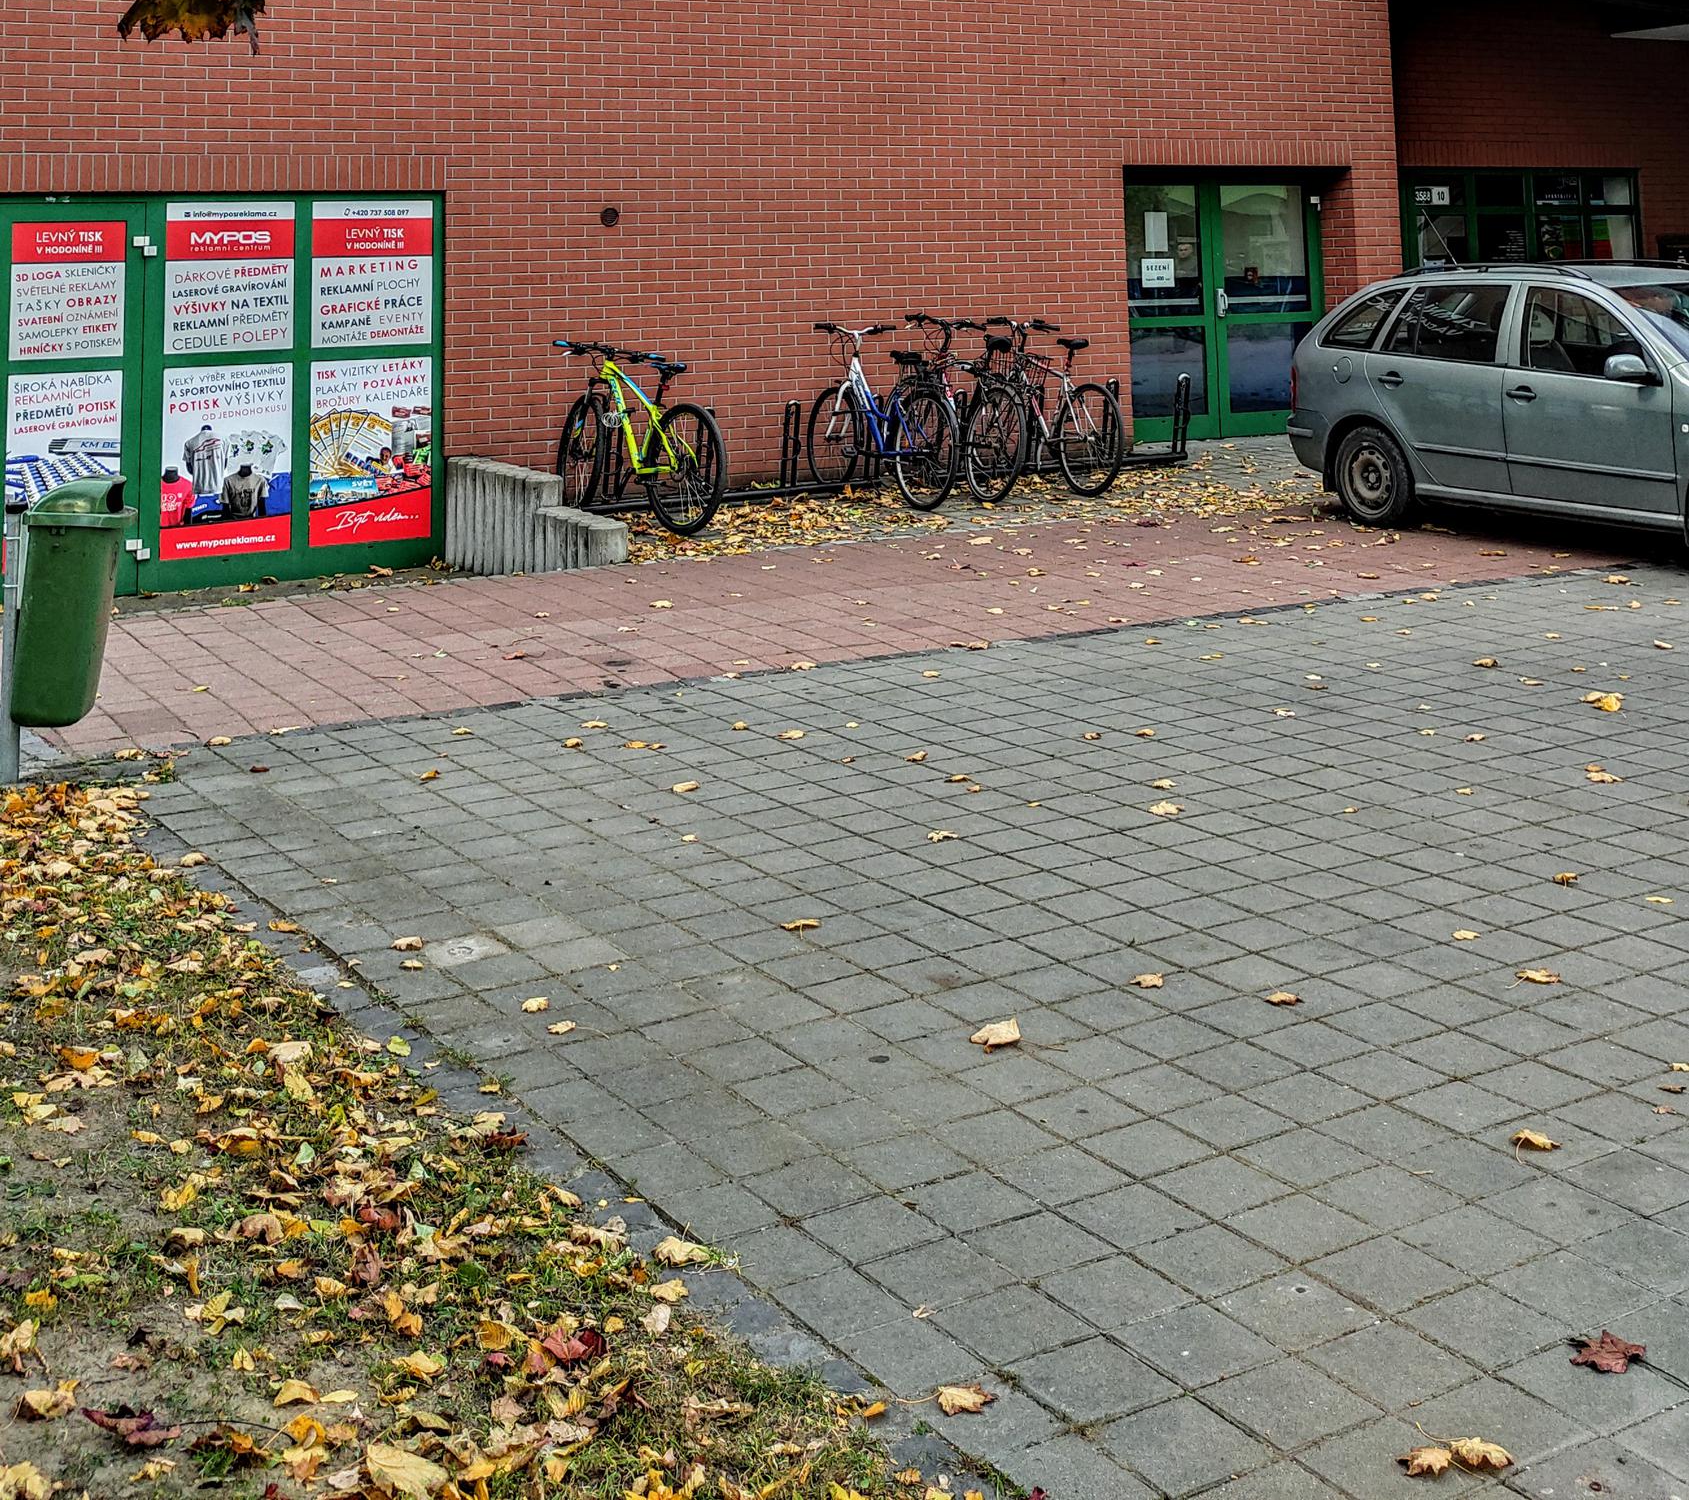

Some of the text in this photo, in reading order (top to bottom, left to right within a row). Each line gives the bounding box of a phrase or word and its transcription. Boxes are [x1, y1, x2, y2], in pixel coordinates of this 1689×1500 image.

[1437, 191, 1445, 201] 10
[193, 210, 277, 219] info@myposreklama.cz
[36, 229, 103, 242] LEVNÝ TISK
[190, 231, 271, 245] MYPOS
[346, 227, 404, 239] LEVNÝ TISK
[36, 246, 42, 254] V
[45, 244, 93, 254] HODONÍNĚ
[354, 240, 396, 249] HODONÍNĚ
[16, 265, 117, 282] 3D LOGA SKLENIČKY
[175, 264, 288, 284] DÁRKOVÉ PŘEDMĚTY
[320, 259, 418, 278] MARKETING
[16, 280, 117, 298] SVĚTELNÉ REKLAMY
[172, 278, 287, 298] LASEROVÉ GRAVÍROVÁNÍ
[320, 278, 420, 296] REKLAMNÍ PLOCHY
[17, 294, 117, 313] TAŠKY OBRAZY
[174, 295, 289, 316] VÝŠIVKY NA TEXTIL
[320, 294, 422, 315] GRAFICKÉ PRÁCE
[18, 308, 119, 327] SVATEBNÍ OZNÁMENÍ
[173, 311, 289, 332] REKLAMNÍ PŘEDMĚTY
[321, 312, 424, 330] KAMPANĚ EVENTY
[18, 323, 118, 341] SAMOLEPKY ETIKETY
[172, 328, 288, 350] CEDULE POLEPY
[322, 325, 424, 344] MONTÁŽE DEMONTÁŽE
[20, 338, 122, 355] HRNÍČKY S POTISKEM
[169, 364, 286, 386] VELKÝ VÝBĚR REKLAMNÍHO
[317, 359, 424, 380] TISK VIZITKY LETÁKY
[14, 374, 112, 394] ŠIROKÁ NABÍDKA
[170, 377, 286, 398] A SPORTOVNÍHO TEXTILU
[316, 374, 426, 396] PLAKÁTY POZVÁNKY
[15, 388, 91, 406] REKLAMNÍCH
[170, 390, 284, 414] POTISK VÝŠIVKY
[316, 386, 429, 408] BROŽURY KALENDÁŘE
[16, 400, 116, 422] PŘEDMĚTŮ POTISK
[202, 404, 287, 421] OD JEDNOHO KUSU
[14, 413, 118, 435] LASEROVÉ GRAVÍROVÁNÍ
[176, 534, 276, 550] www.myposreklama.cz
